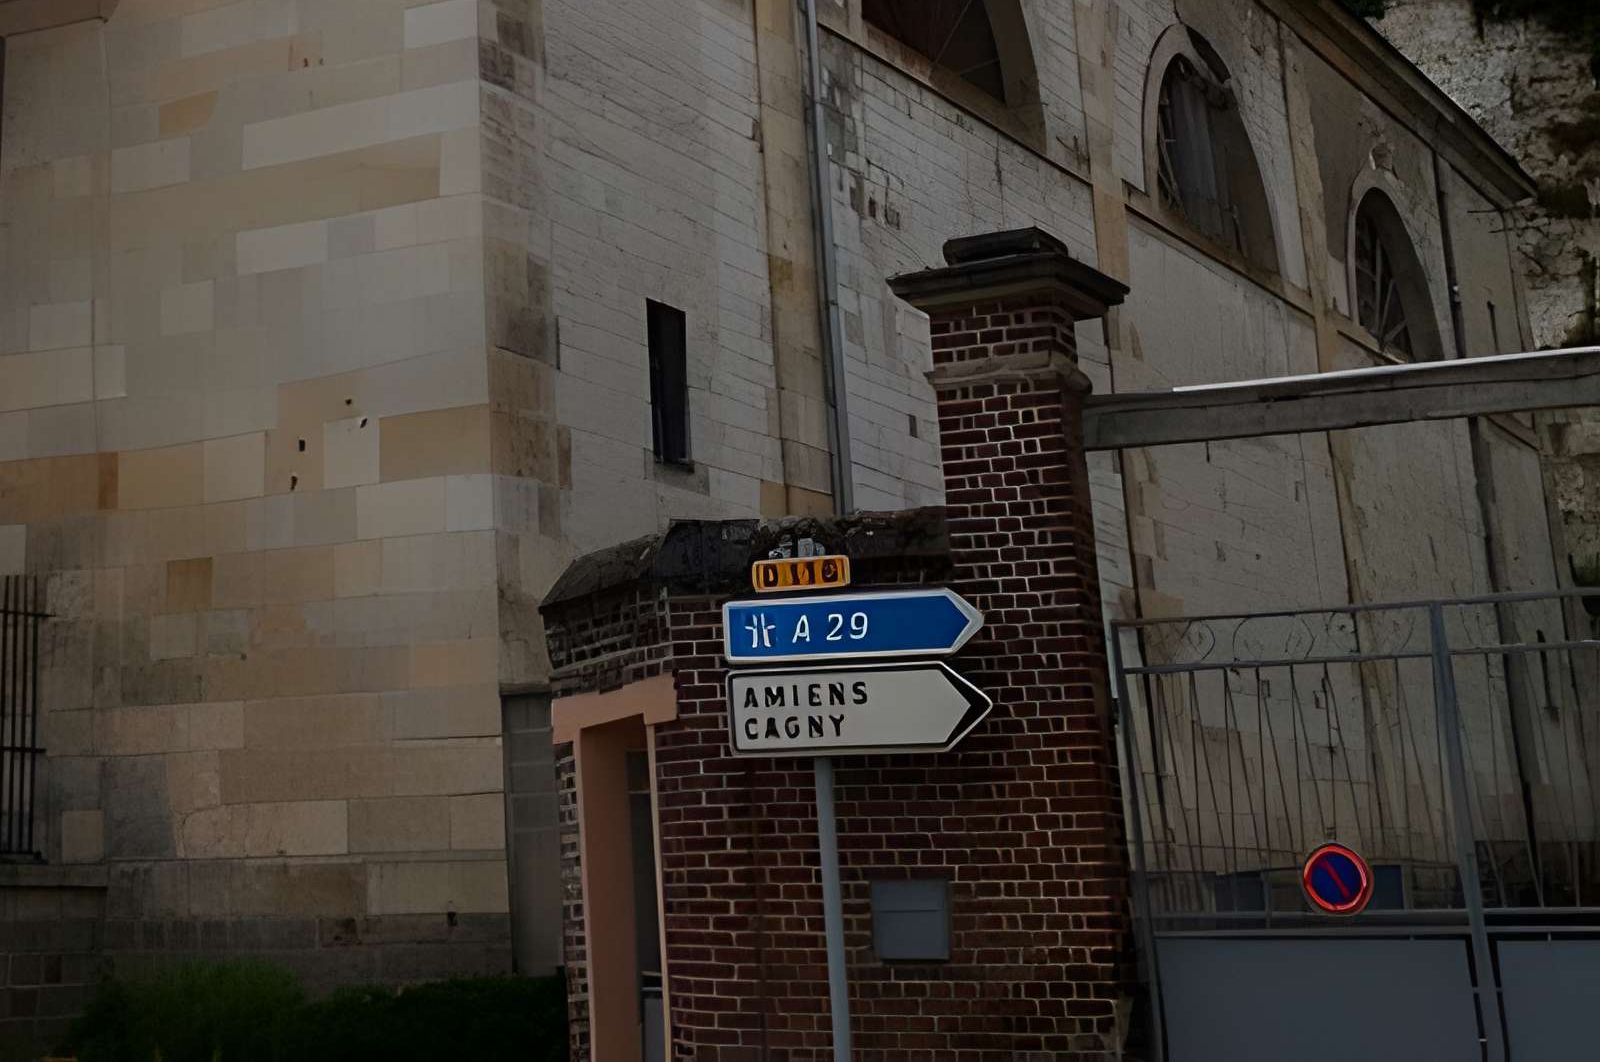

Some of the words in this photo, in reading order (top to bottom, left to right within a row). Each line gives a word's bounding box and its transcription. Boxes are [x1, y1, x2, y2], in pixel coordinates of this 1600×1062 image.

[792, 614, 811, 643] A
[826, 611, 869, 642] 29
[743, 681, 868, 709] AMIENS
[743, 713, 846, 741] CAGNY
